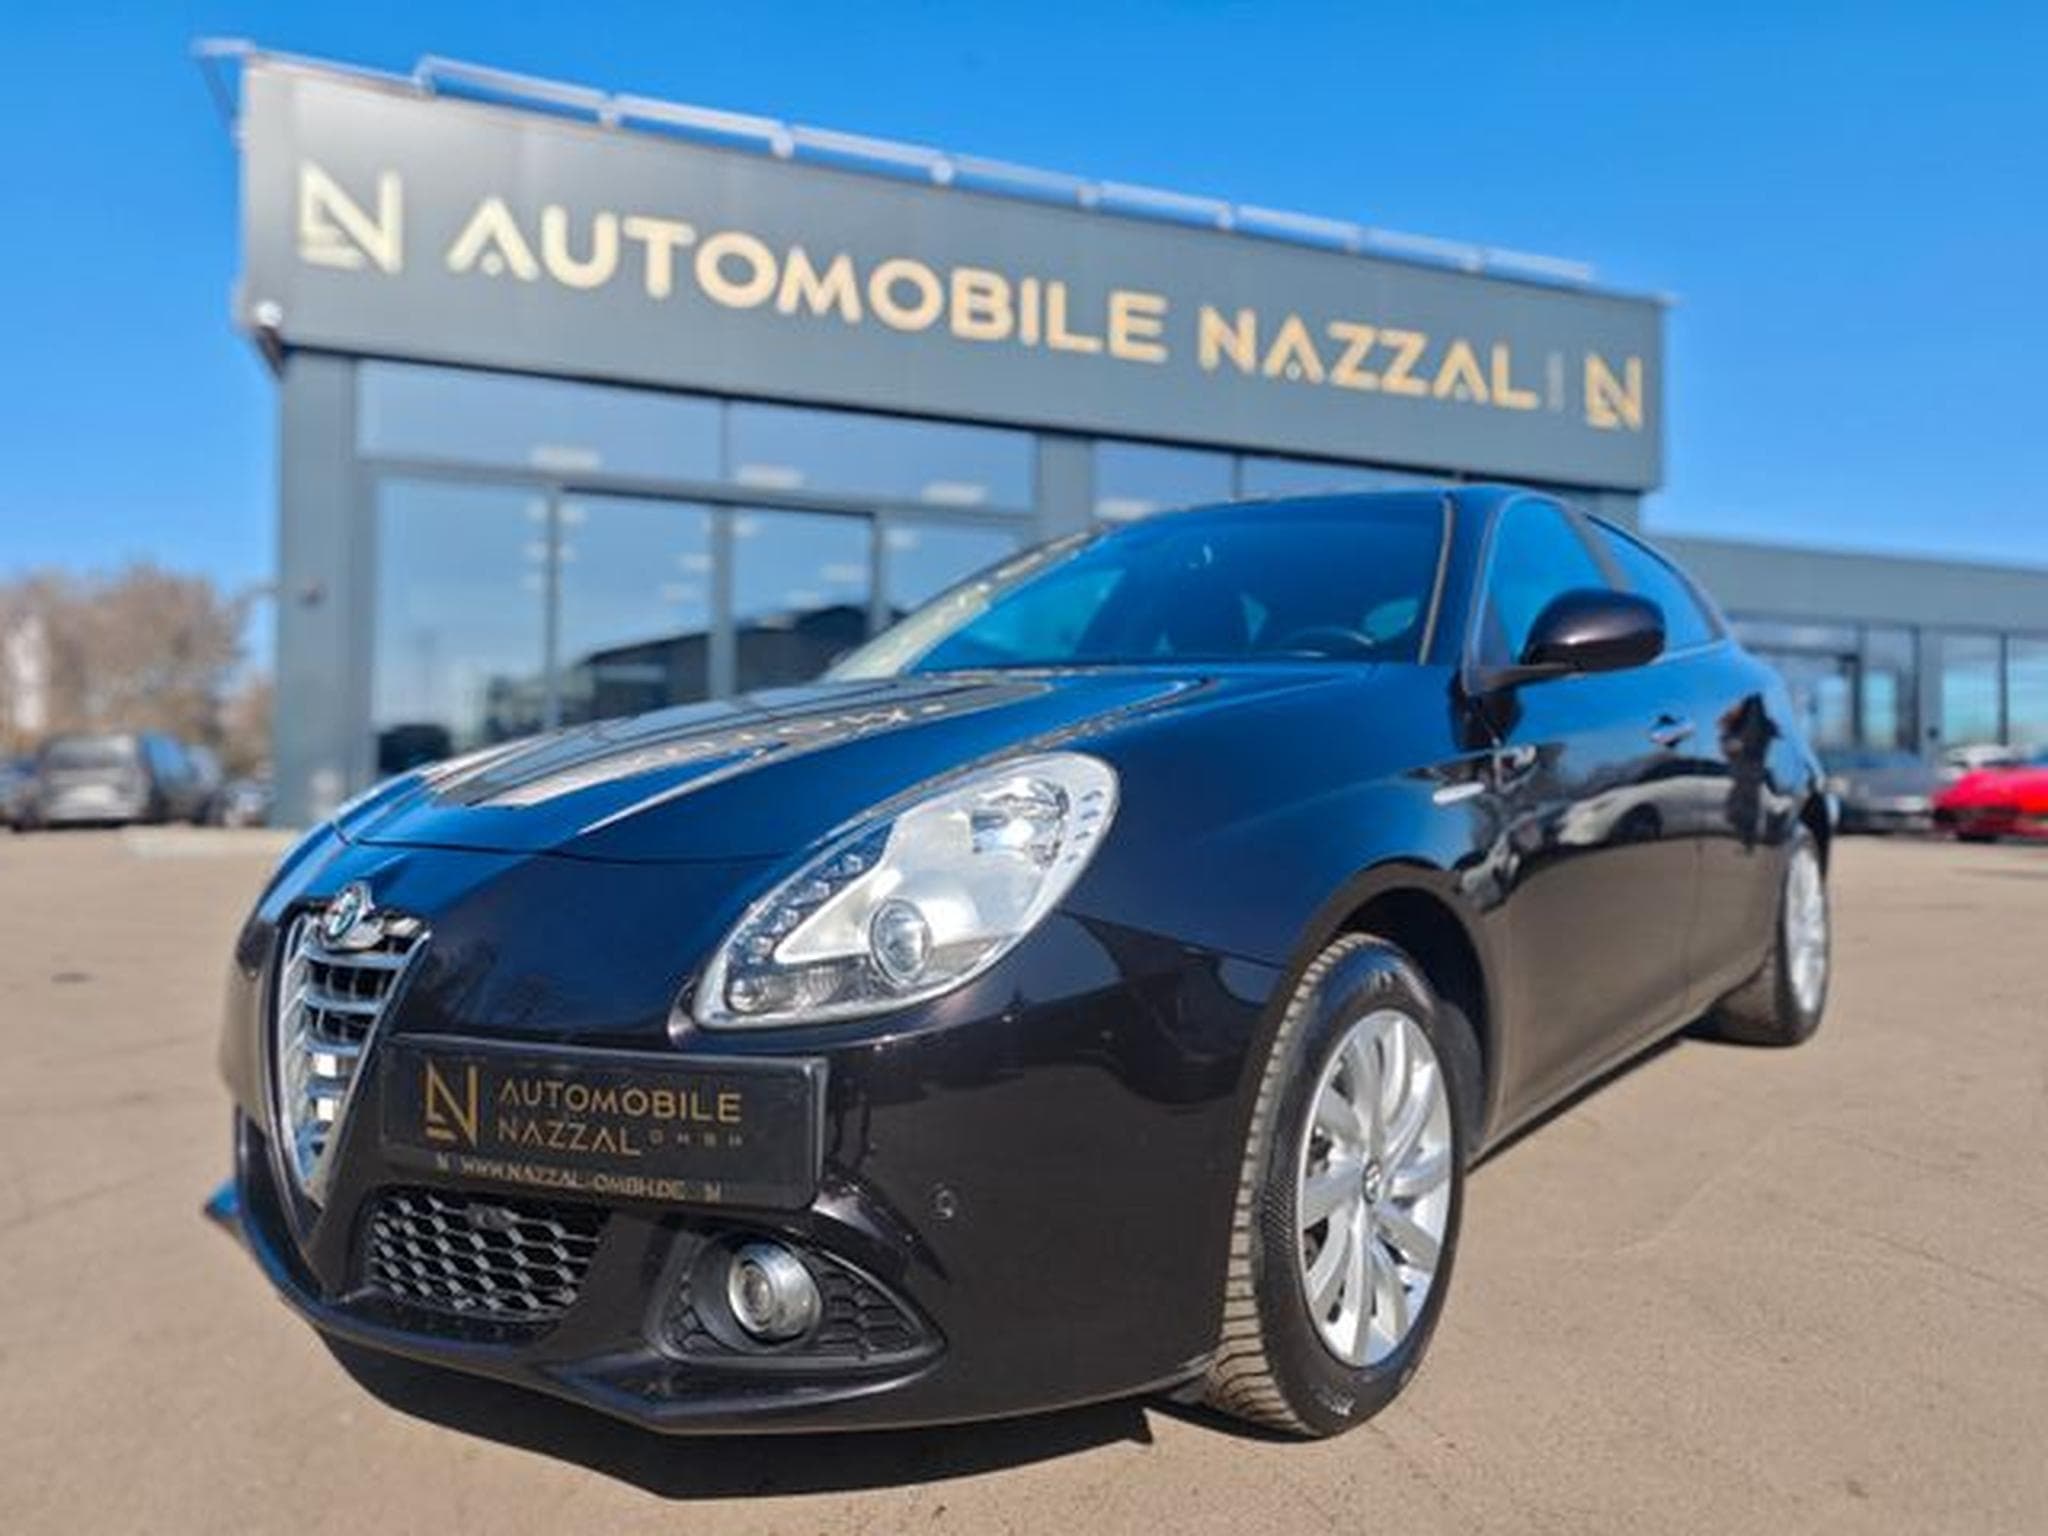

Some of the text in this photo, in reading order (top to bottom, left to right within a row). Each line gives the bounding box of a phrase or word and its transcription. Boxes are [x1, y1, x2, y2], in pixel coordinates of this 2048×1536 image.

[447, 197, 1168, 363] AUTOMOBILE
[1199, 305, 1538, 410] NAZZAL
[500, 1079, 742, 1123] AUTOMOBILE
[499, 1119, 641, 1156] NAZZAL
